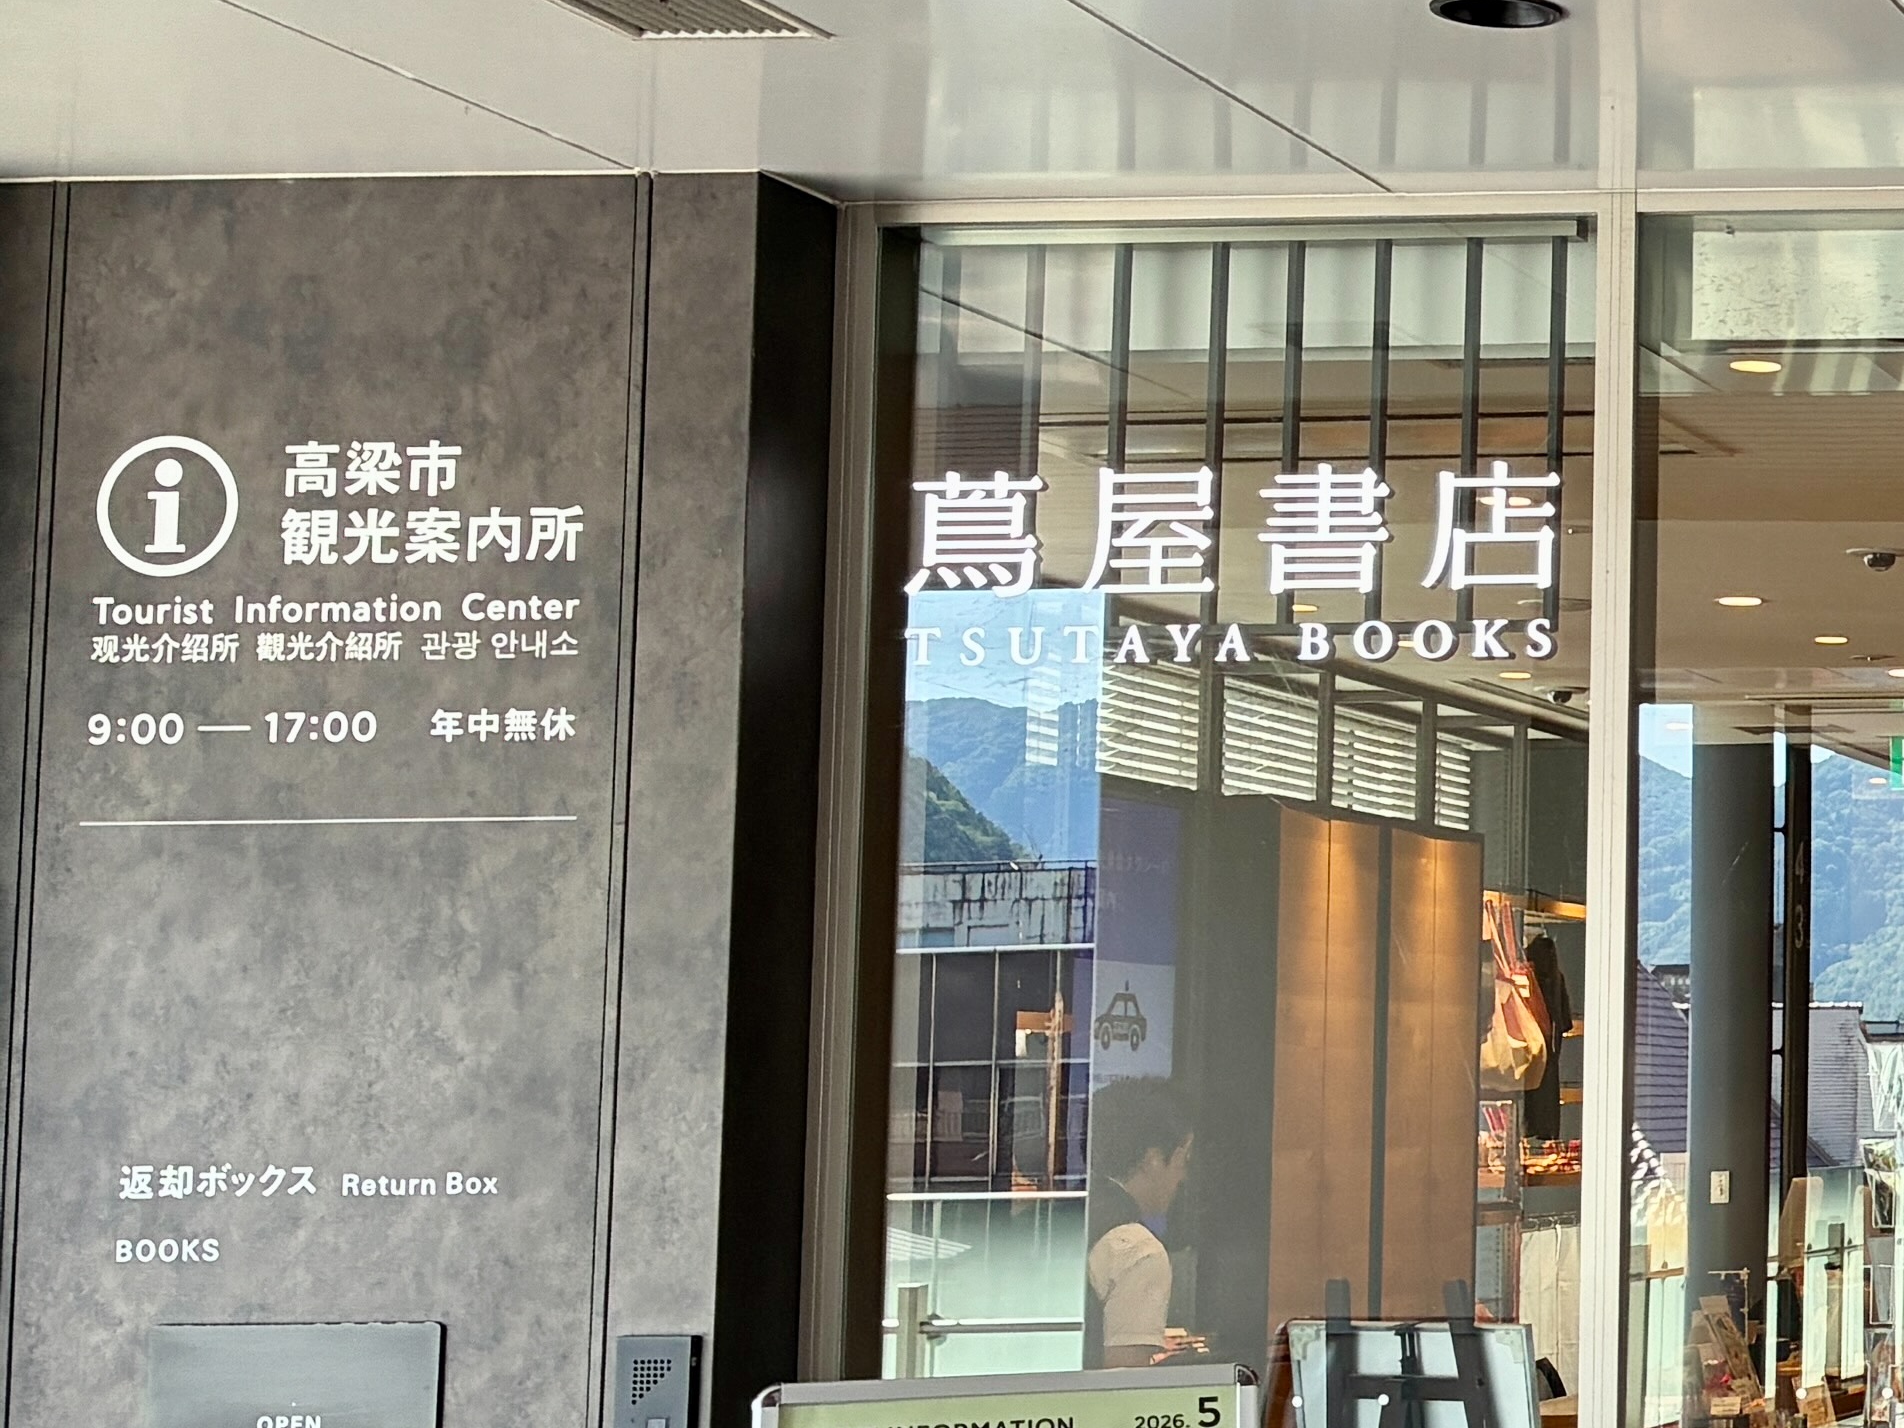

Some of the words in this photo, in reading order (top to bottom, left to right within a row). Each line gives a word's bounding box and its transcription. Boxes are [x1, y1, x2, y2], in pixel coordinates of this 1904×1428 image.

[285, 438, 462, 497] 高梁市
[280, 505, 585, 567] 観光案内所
[904, 461, 1563, 599] 蔦屋書店
[92, 596, 213, 626] Tourist
[233, 593, 441, 624] Information
[461, 592, 580, 622] Center
[90, 634, 239, 663] 观光介绍所
[256, 632, 403, 662] 觀光介紹所
[420, 632, 480, 661] 관광
[492, 632, 579, 660] 안내소
[904, 623, 1251, 667] TSUTAYA
[1296, 617, 1555, 662] BOOKS
[87, 712, 184, 746] 9:00
[264, 710, 377, 743] 17:00
[430, 707, 576, 743] 年中無休
[119, 1165, 318, 1200] 返却ボックス
[341, 1173, 436, 1197] Return
[445, 1172, 498, 1196] Box
[115, 1239, 220, 1263] BOOKS
[1197, 1396, 1221, 1428] 5
